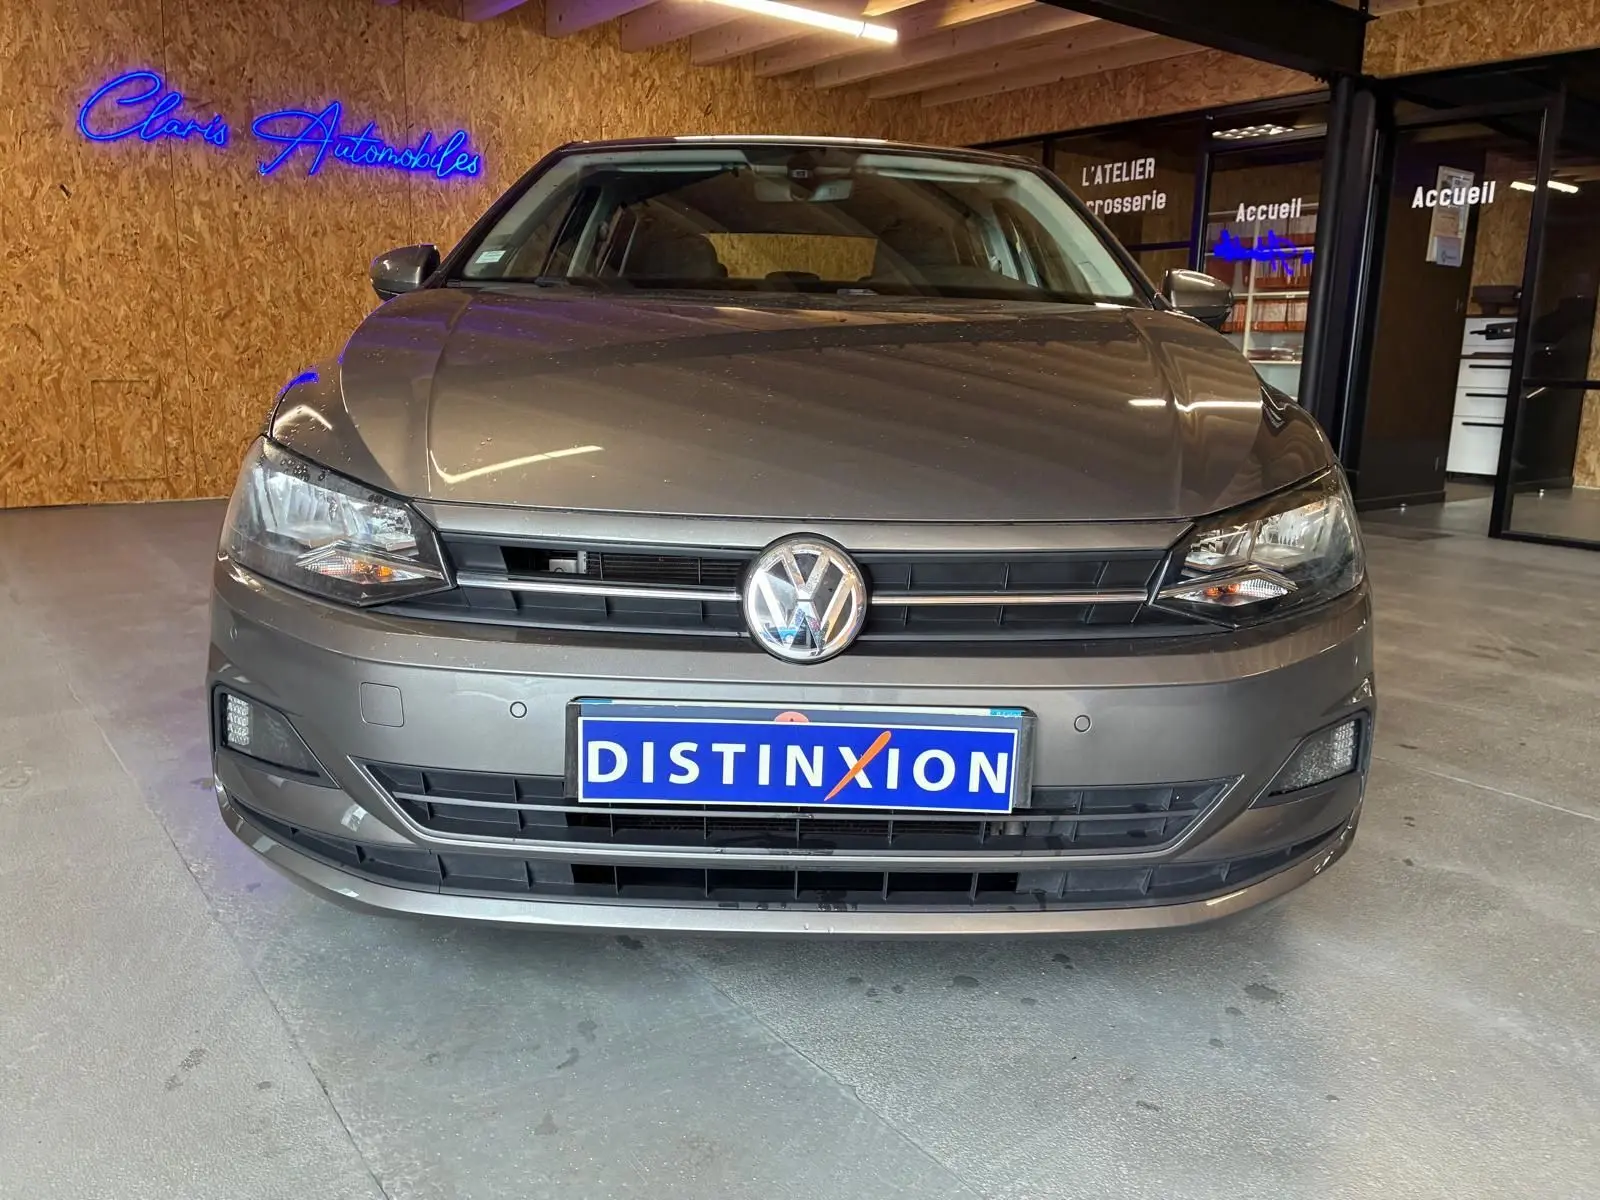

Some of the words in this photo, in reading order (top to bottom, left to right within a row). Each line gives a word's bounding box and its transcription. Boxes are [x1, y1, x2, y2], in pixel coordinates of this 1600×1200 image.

[80, 71, 228, 146] Claris
[252, 102, 482, 177] Automobiles
[1082, 157, 1155, 187] L'ATELIER
[1235, 197, 1302, 222] Accueil
[1411, 180, 1496, 209] Accueil
[587, 730, 1008, 800] DISTINXION
